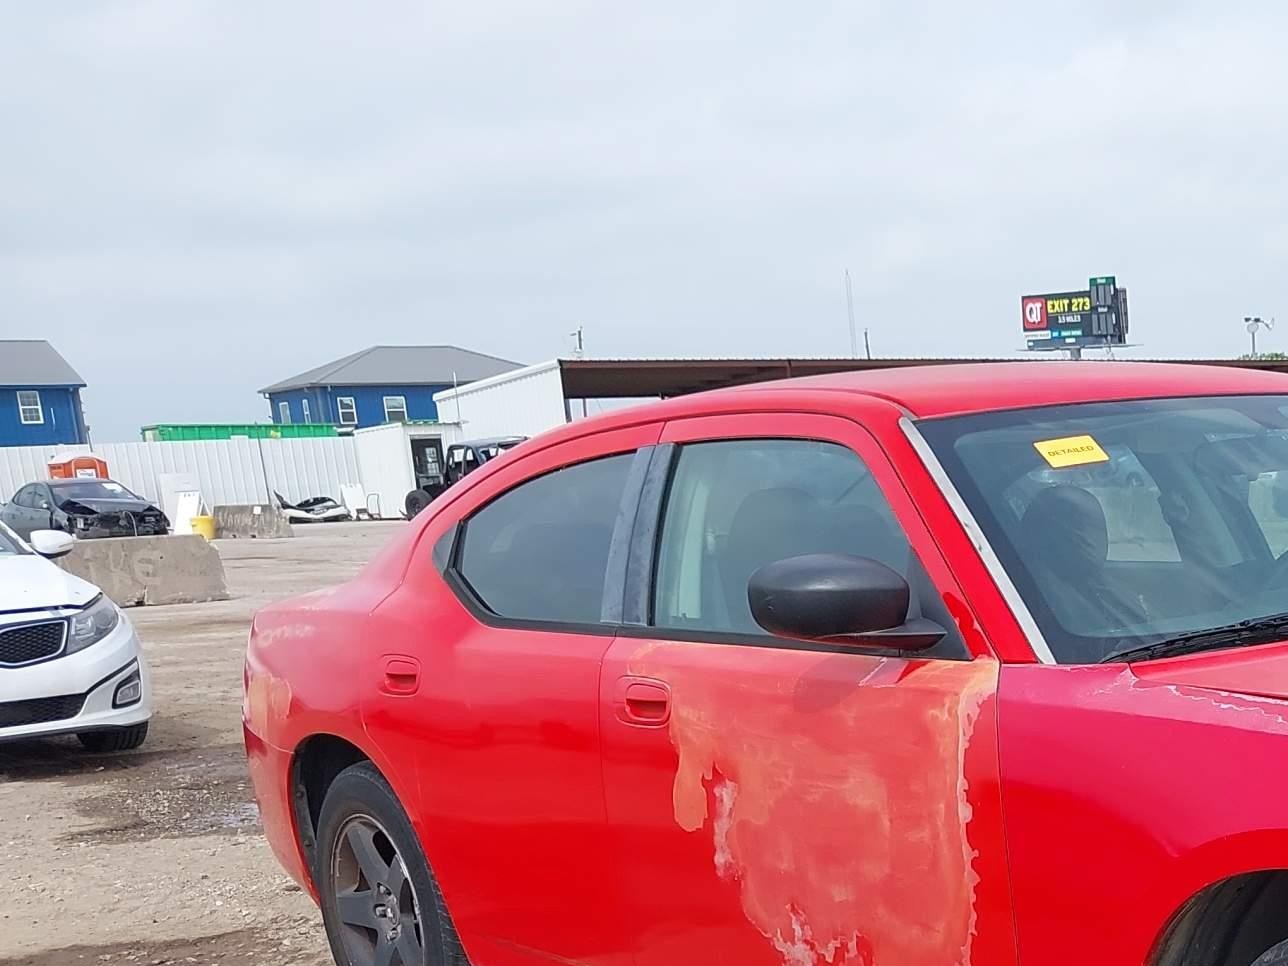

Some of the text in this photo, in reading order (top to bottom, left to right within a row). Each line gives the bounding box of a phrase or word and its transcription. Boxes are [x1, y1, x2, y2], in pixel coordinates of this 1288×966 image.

[1025, 302, 1042, 324] QT
[1047, 297, 1090, 314] EXIT 273
[1047, 446, 1095, 457] DETAILED
